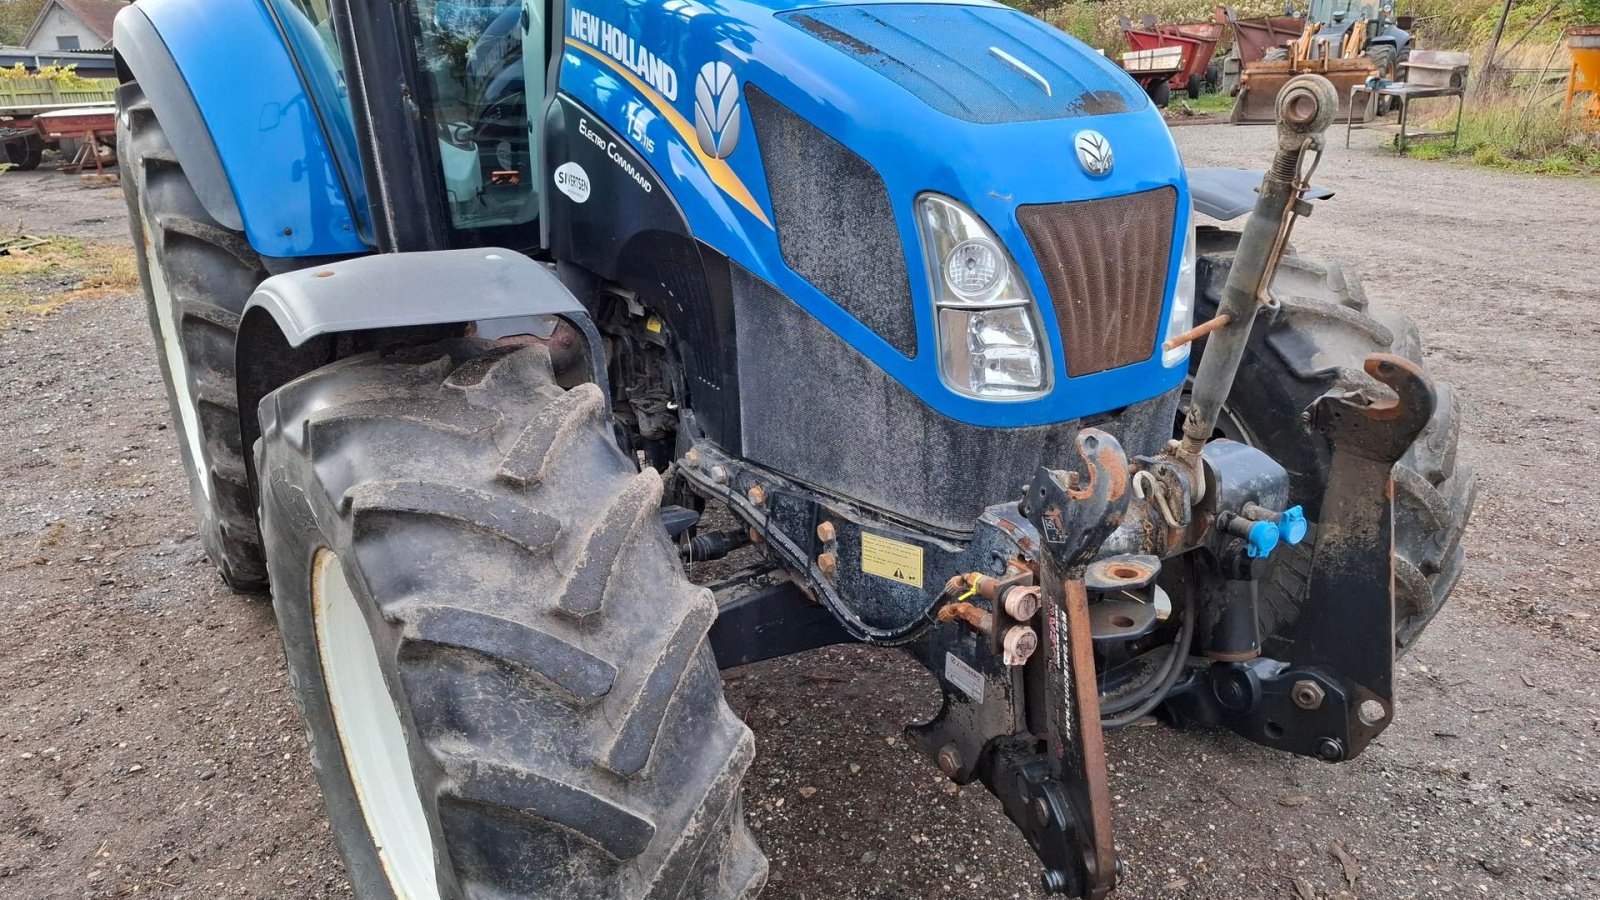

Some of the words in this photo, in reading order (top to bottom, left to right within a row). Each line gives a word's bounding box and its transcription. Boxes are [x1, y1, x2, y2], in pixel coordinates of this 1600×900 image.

[571, 8, 599, 47] NEW
[602, 21, 678, 102] HOLLAND
[625, 114, 655, 154] T5.115
[558, 171, 589, 193] SIVERTSEN
